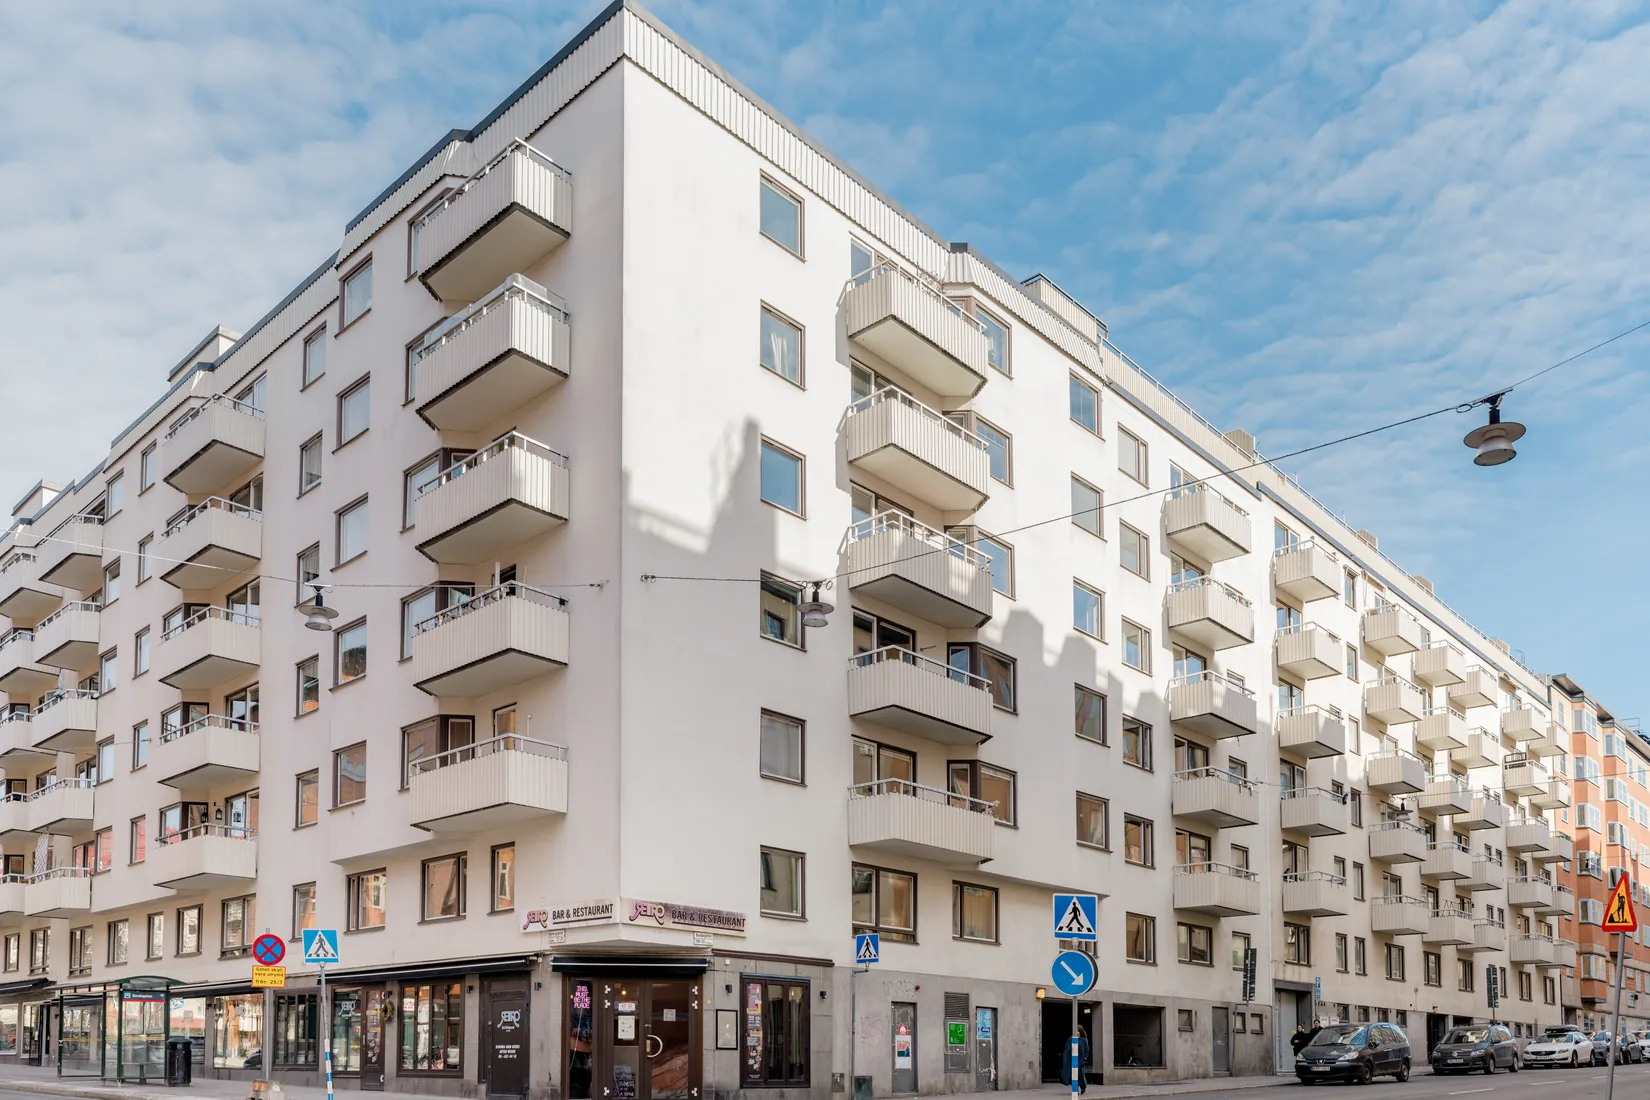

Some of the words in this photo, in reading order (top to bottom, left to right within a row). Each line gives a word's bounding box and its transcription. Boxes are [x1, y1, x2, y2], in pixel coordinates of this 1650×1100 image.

[552, 909, 564, 920] BAR
[566, 909, 571, 918] &
[572, 904, 613, 917] RESTAURANT
[629, 903, 665, 925] RETRO
[671, 910, 687, 921] BAR
[689, 912, 695, 921] &
[698, 913, 746, 927] RESTAURANT
